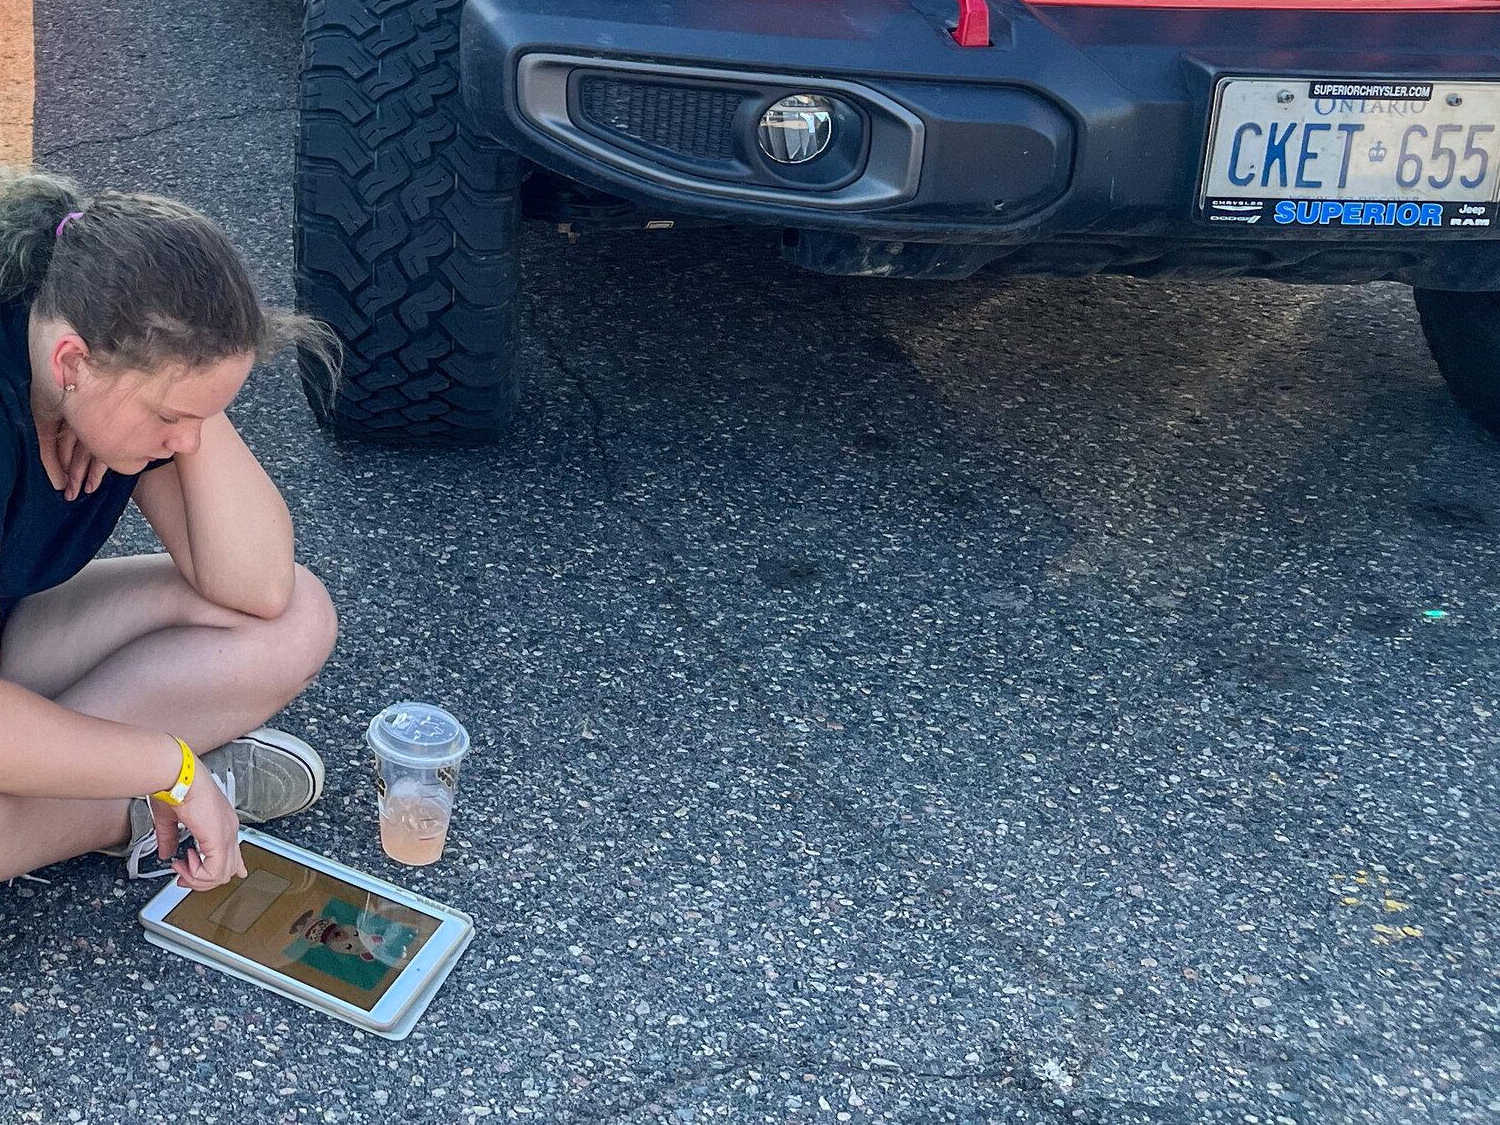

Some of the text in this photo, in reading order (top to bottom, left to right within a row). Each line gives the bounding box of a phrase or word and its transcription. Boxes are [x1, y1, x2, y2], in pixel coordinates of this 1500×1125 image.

[1313, 84, 1431, 98] SUPERIORCHRYSLER.COM
[1227, 121, 1495, 189] CKET 655
[1273, 200, 1444, 226] SUPERIOR
[1458, 203, 1486, 216] Jeep
[1450, 218, 1490, 226] RAM
